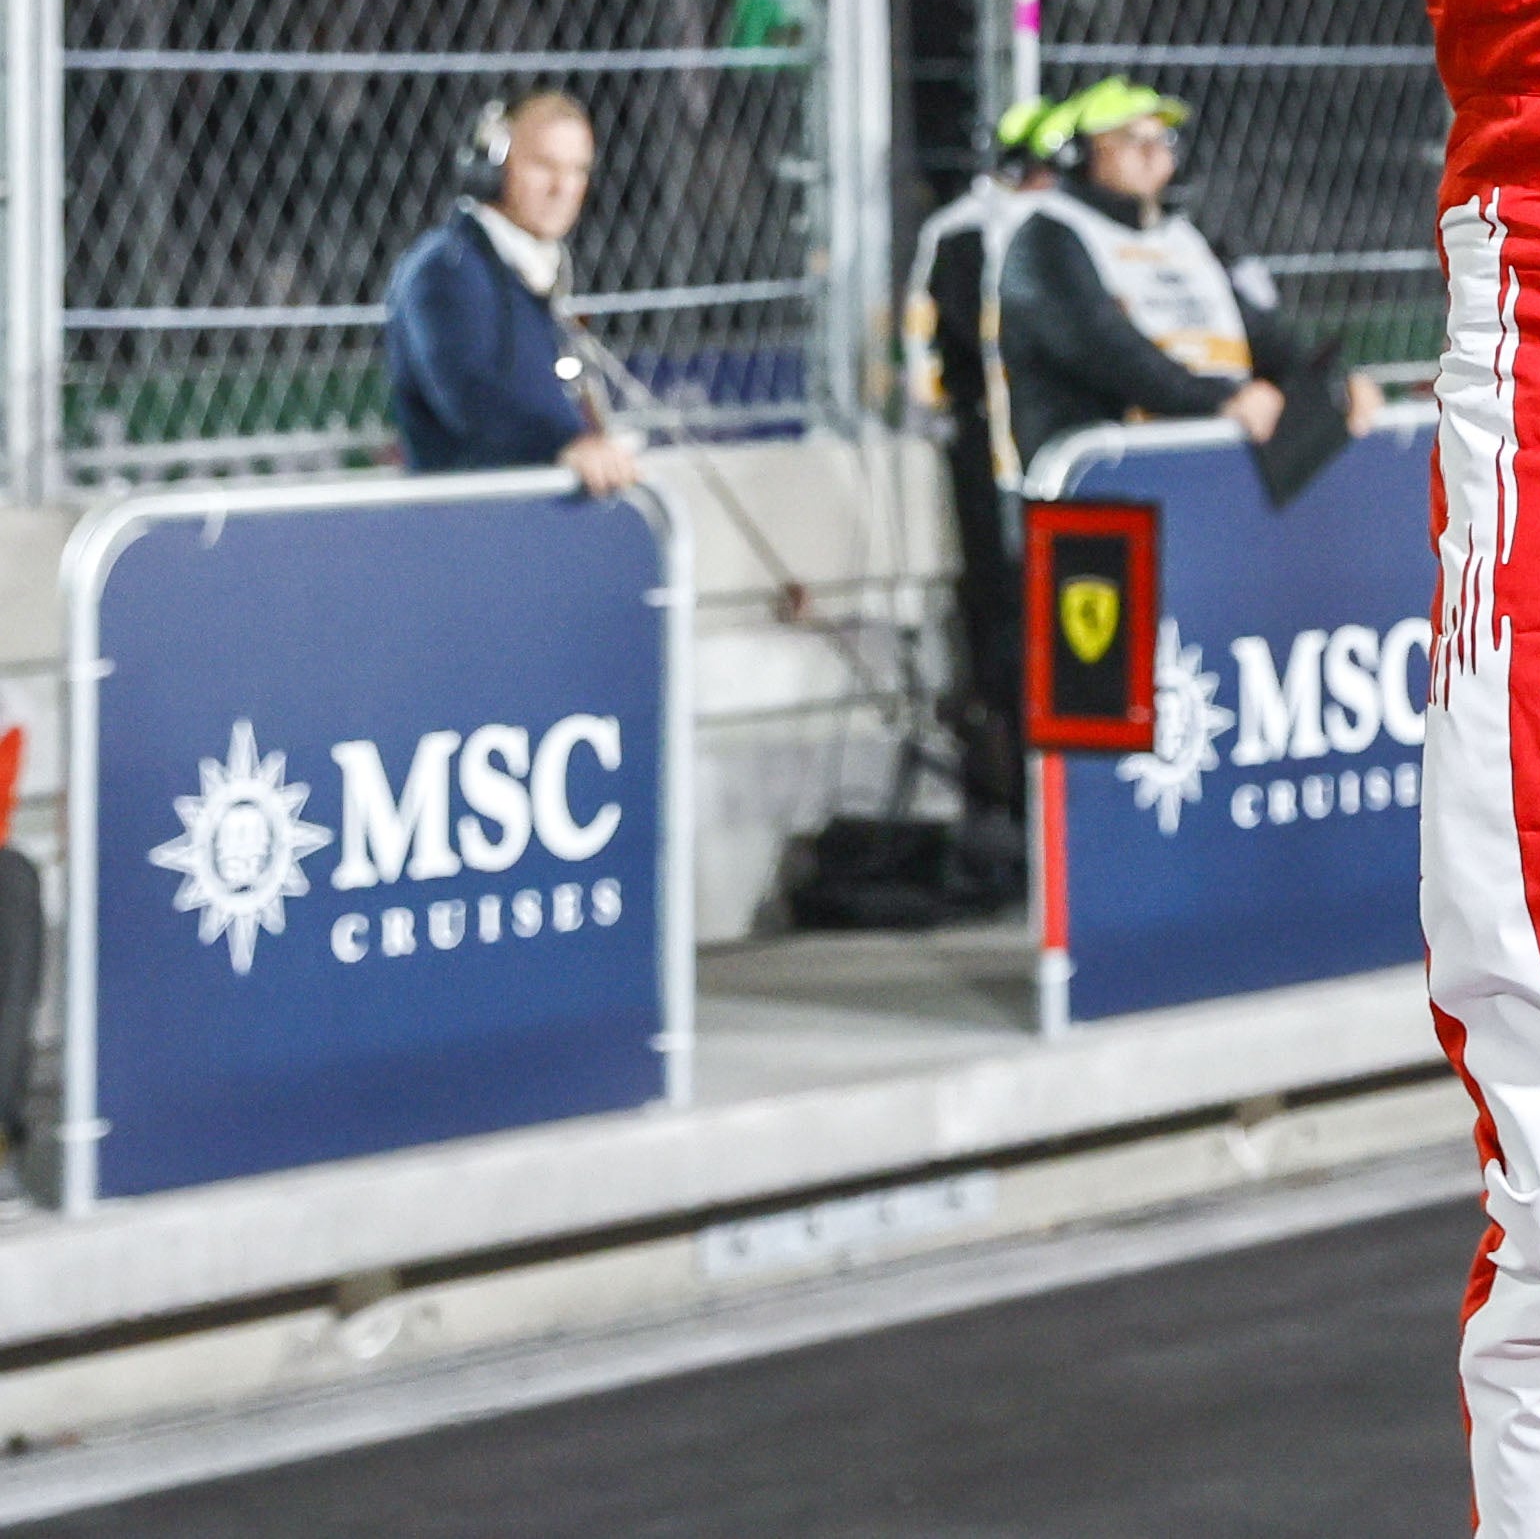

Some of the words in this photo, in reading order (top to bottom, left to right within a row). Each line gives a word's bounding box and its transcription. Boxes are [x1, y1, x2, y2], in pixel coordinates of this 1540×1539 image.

[1230, 617, 1433, 767] MSC
[331, 713, 622, 891] MSC
[1231, 763, 1421, 830] CRUISE
[331, 878, 622, 963] CRUISES
